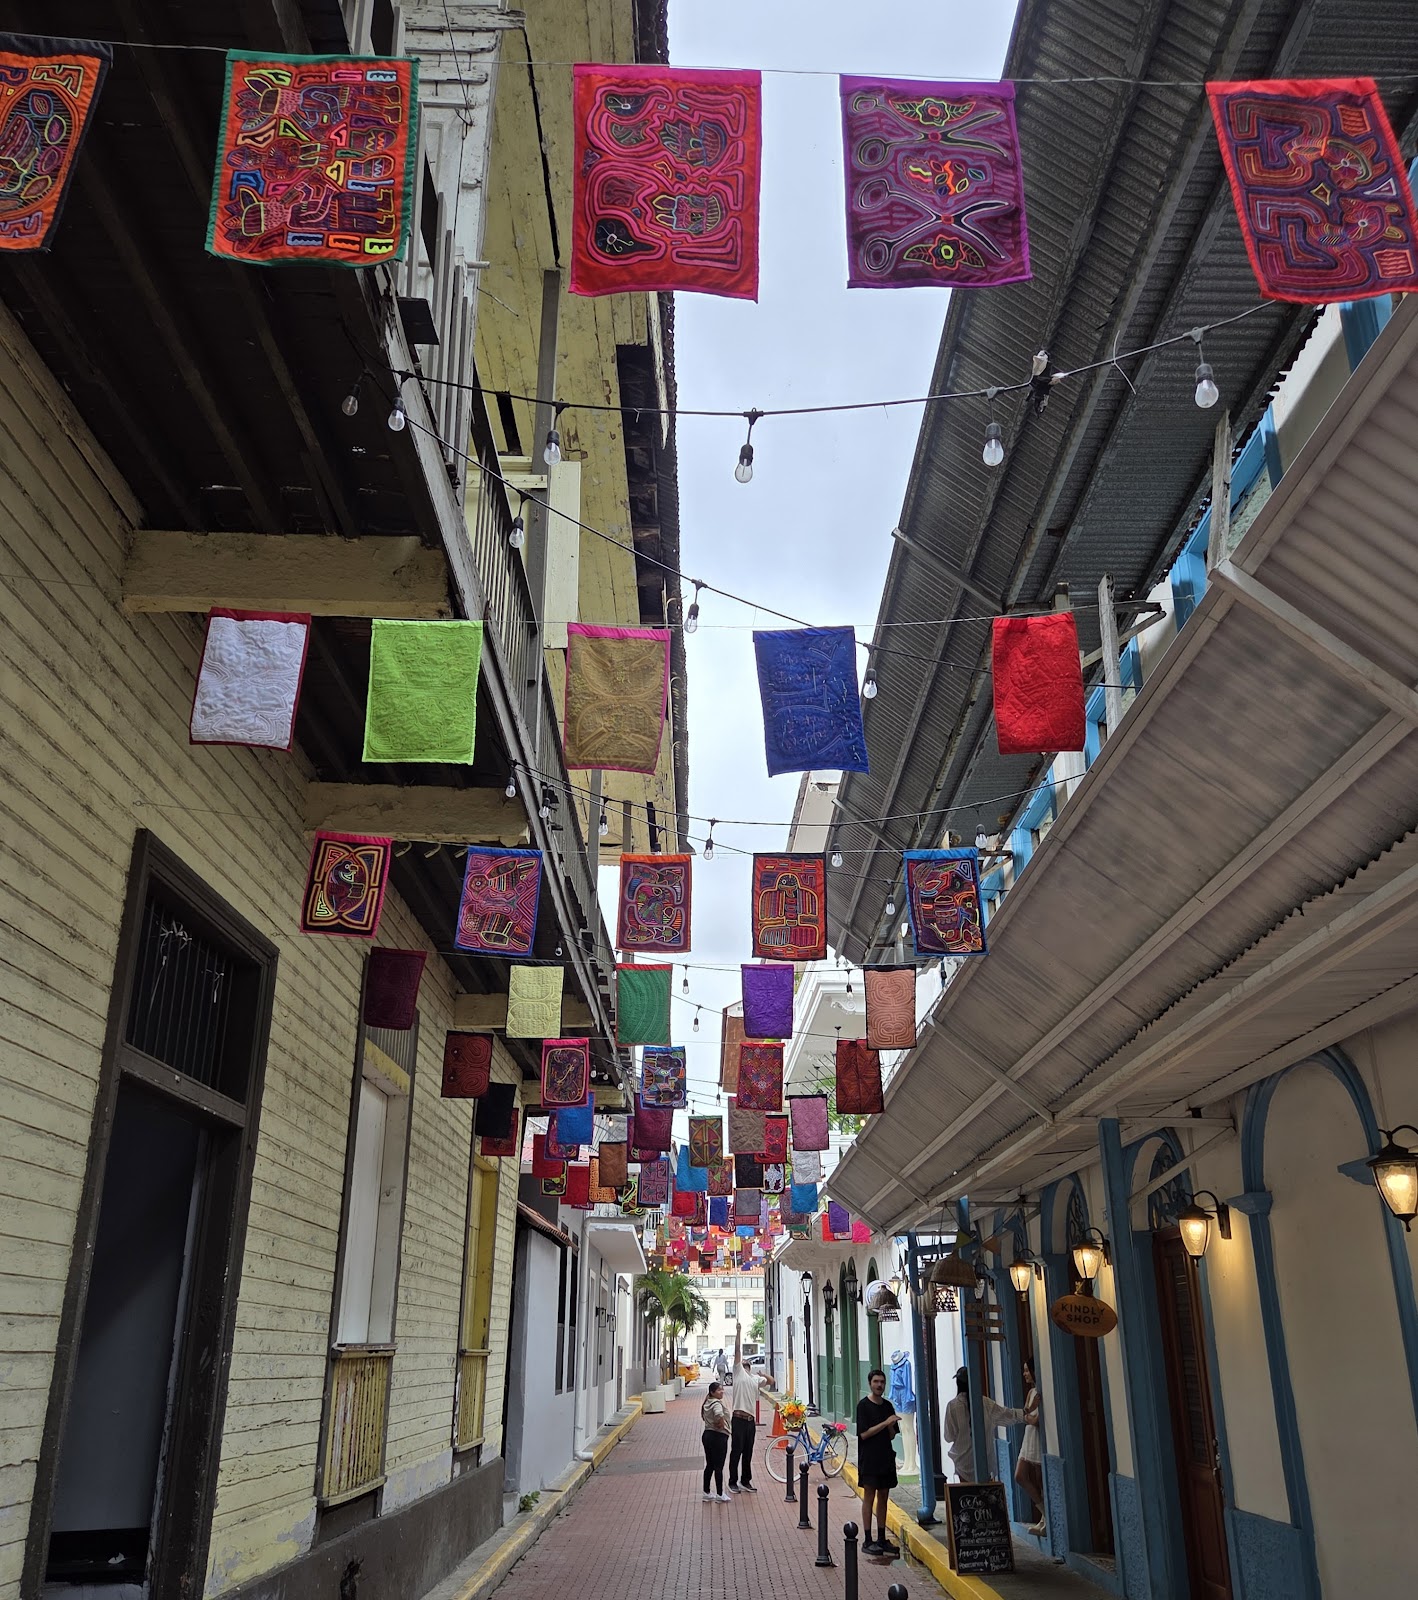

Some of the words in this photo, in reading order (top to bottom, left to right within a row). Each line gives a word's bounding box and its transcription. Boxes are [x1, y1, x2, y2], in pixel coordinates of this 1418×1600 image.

[1061, 1303, 1105, 1316] KINDLY
[1066, 1314, 1100, 1325] SHOP
[974, 1508, 993, 1521] OPEN
[958, 1546, 990, 1560] Amazing
